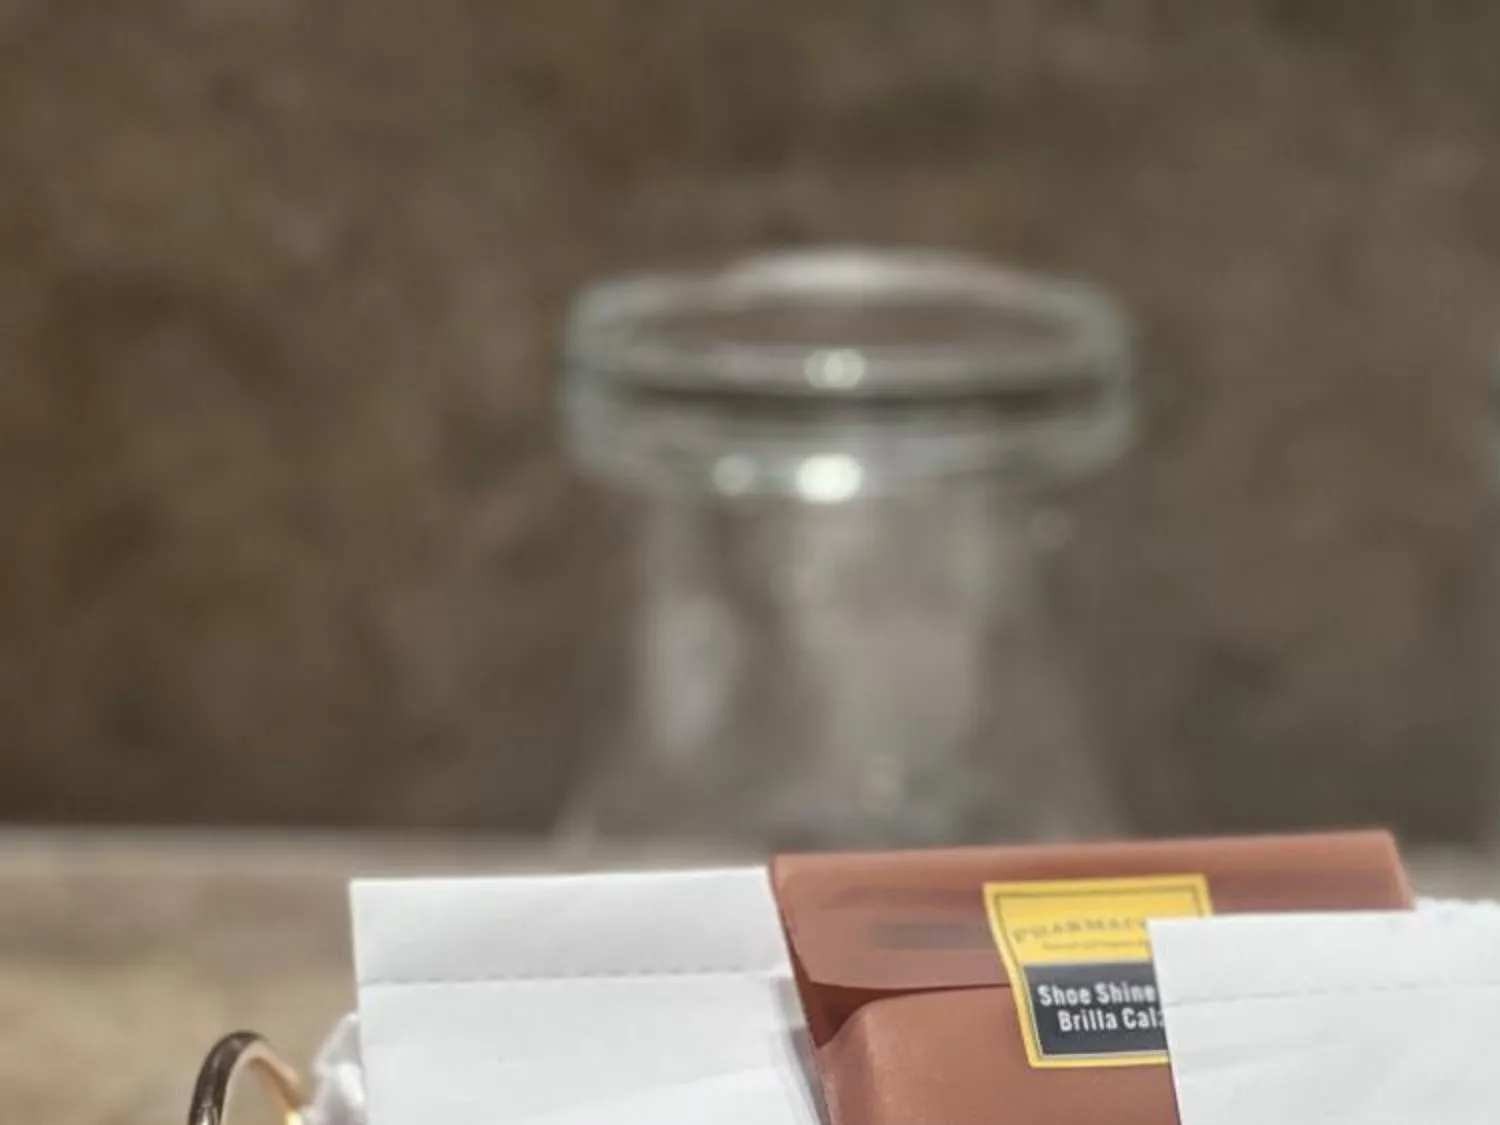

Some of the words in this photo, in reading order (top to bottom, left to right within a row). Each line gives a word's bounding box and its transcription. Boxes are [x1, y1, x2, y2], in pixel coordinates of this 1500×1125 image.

[1037, 983, 1092, 1007] Shoe
[1094, 980, 1155, 1004] Shine
[1057, 1009, 1118, 1032] Brilla
